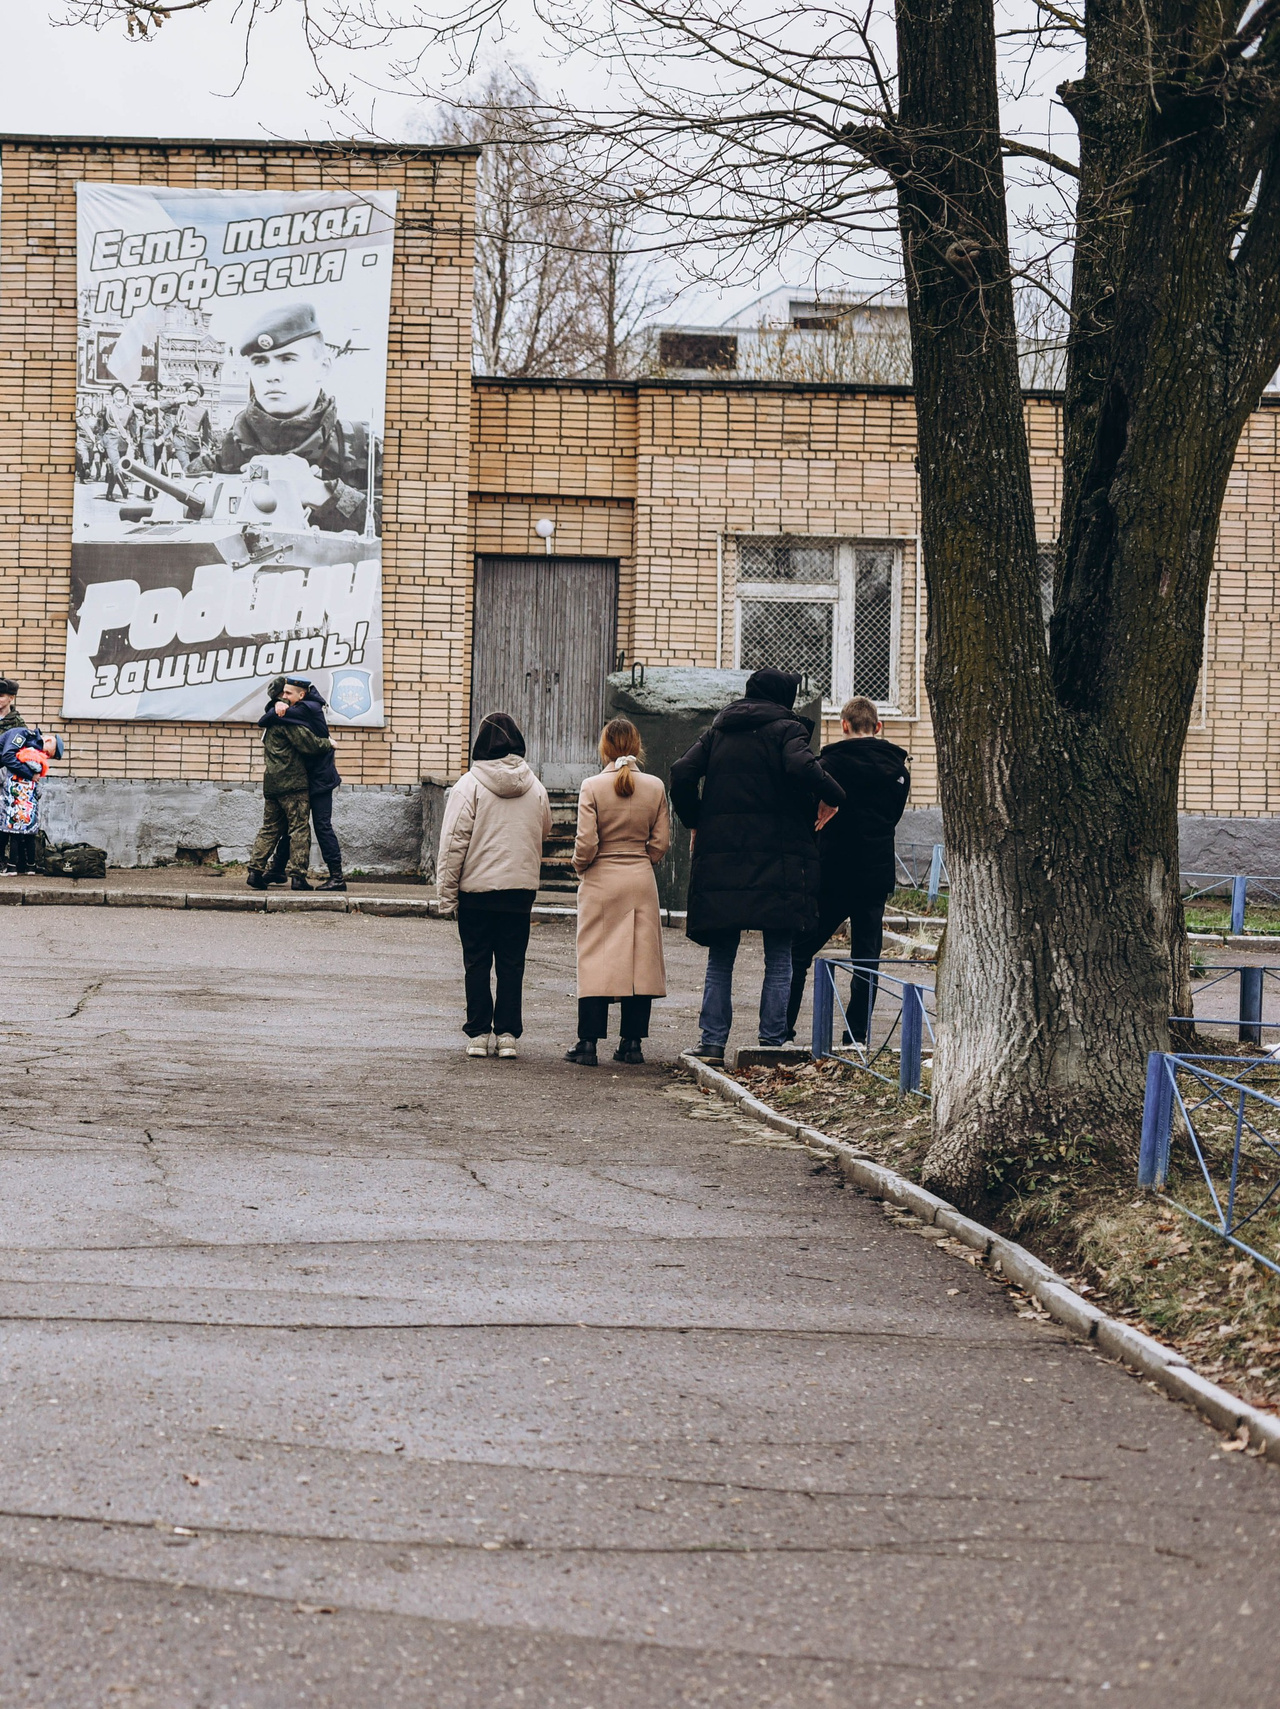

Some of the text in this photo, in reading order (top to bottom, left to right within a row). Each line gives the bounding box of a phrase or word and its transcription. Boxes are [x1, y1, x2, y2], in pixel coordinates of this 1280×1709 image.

[90, 203, 374, 271] Есть такая
[94, 248, 347, 318] профессия
